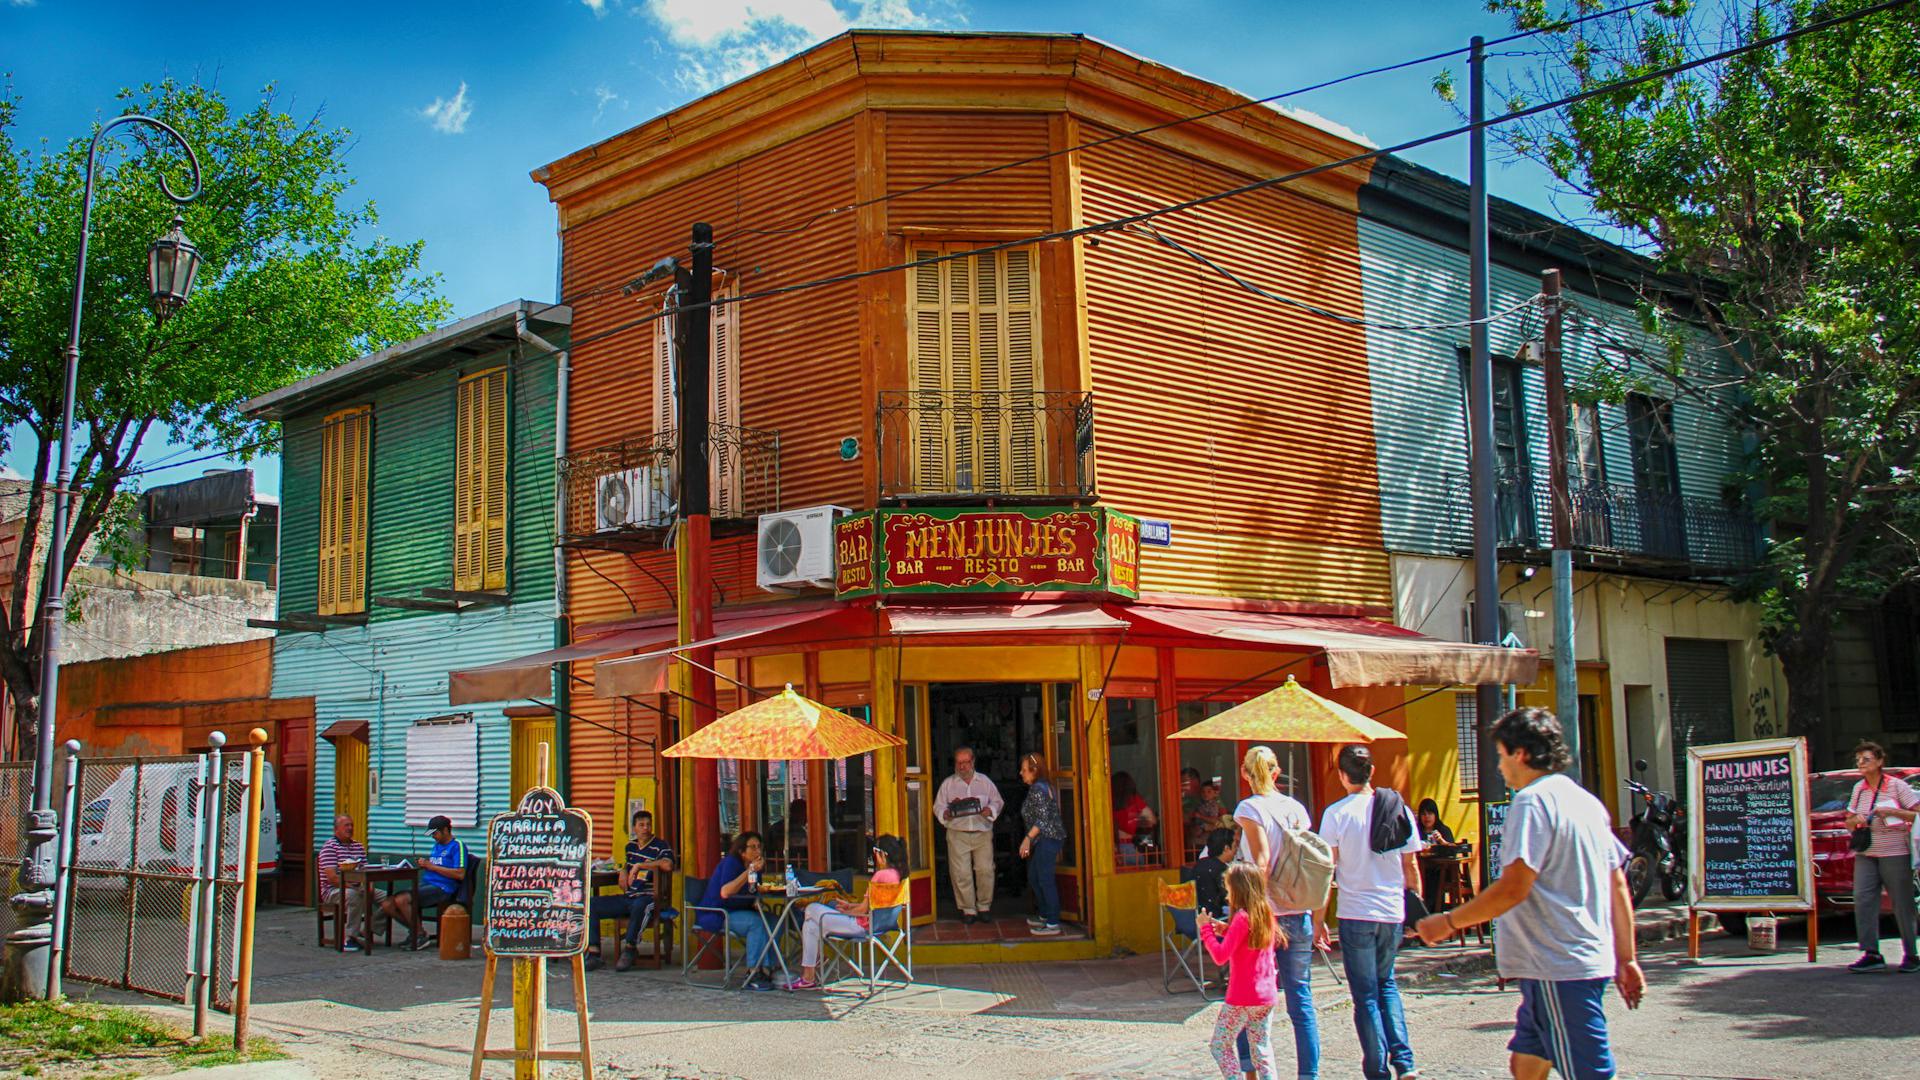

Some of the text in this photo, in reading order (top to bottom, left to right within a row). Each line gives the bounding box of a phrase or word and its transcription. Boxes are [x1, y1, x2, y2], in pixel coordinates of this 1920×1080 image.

[906, 518, 1079, 560] MENJUNJES
[839, 534, 869, 566] BAR
[1110, 534, 1137, 566] BAR
[896, 557, 1086, 575] BAR RESTO BAR
[1113, 563, 1135, 583] RESTO
[842, 566, 866, 584] RESTO
[1704, 757, 1791, 781] MENJUNJES
[521, 799, 554, 815] HOY
[1706, 804, 1745, 813] CASERAS
[494, 820, 567, 834] PARRILLA
[498, 844, 507, 858] 2
[492, 865, 577, 880] PIZZA GRANDE
[493, 897, 551, 909] TOSTADOS
[491, 918, 537, 931] PASTAS
